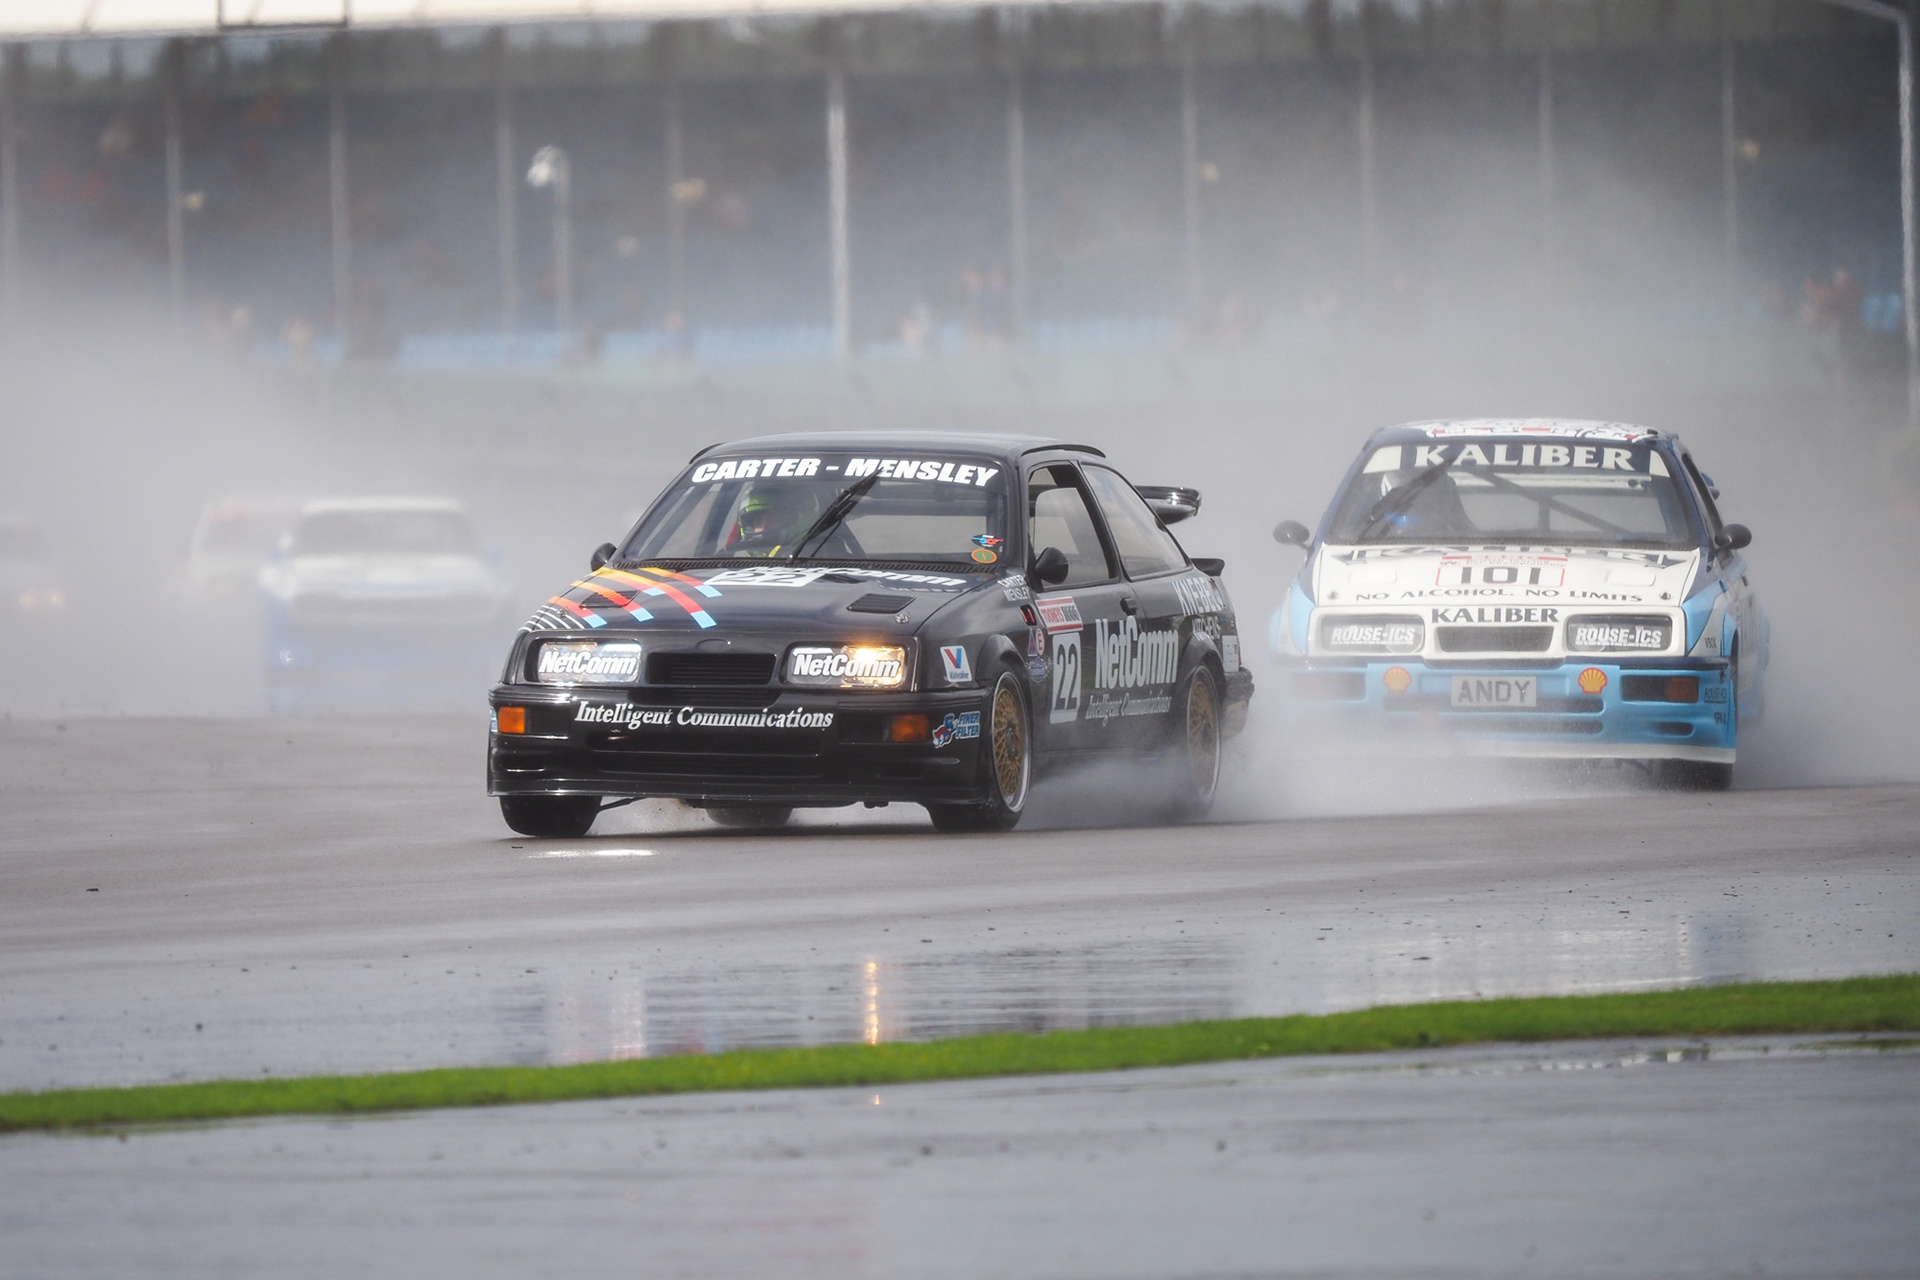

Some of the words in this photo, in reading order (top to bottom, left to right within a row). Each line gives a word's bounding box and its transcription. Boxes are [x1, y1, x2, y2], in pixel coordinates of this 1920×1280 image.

[1415, 443, 1635, 472] KALIBER
[691, 458, 822, 483] CARTER
[844, 458, 998, 487] MENSLEY
[711, 572, 807, 584] 22
[997, 574, 1027, 588] CARTER
[1460, 566, 1541, 585] 101
[1355, 592, 1390, 601] NO
[1401, 588, 1515, 599] ALCOHOL.
[1525, 589, 1560, 599] NO
[1570, 590, 1643, 602] LIMITS
[1431, 608, 1560, 624] KALIBER
[1331, 626, 1416, 642] ROUSE-ICS
[1575, 626, 1662, 645] ROUSE-ICS
[539, 651, 638, 675] NetComm
[1094, 614, 1179, 689] NetComm
[793, 653, 902, 678] NetComm
[1057, 643, 1079, 711] 22
[1457, 679, 1530, 703] ANDY
[574, 700, 671, 730] Intelligent
[676, 706, 834, 729] Communications
[1085, 693, 1122, 727] Intelligent
[1121, 688, 1172, 717] Communications
